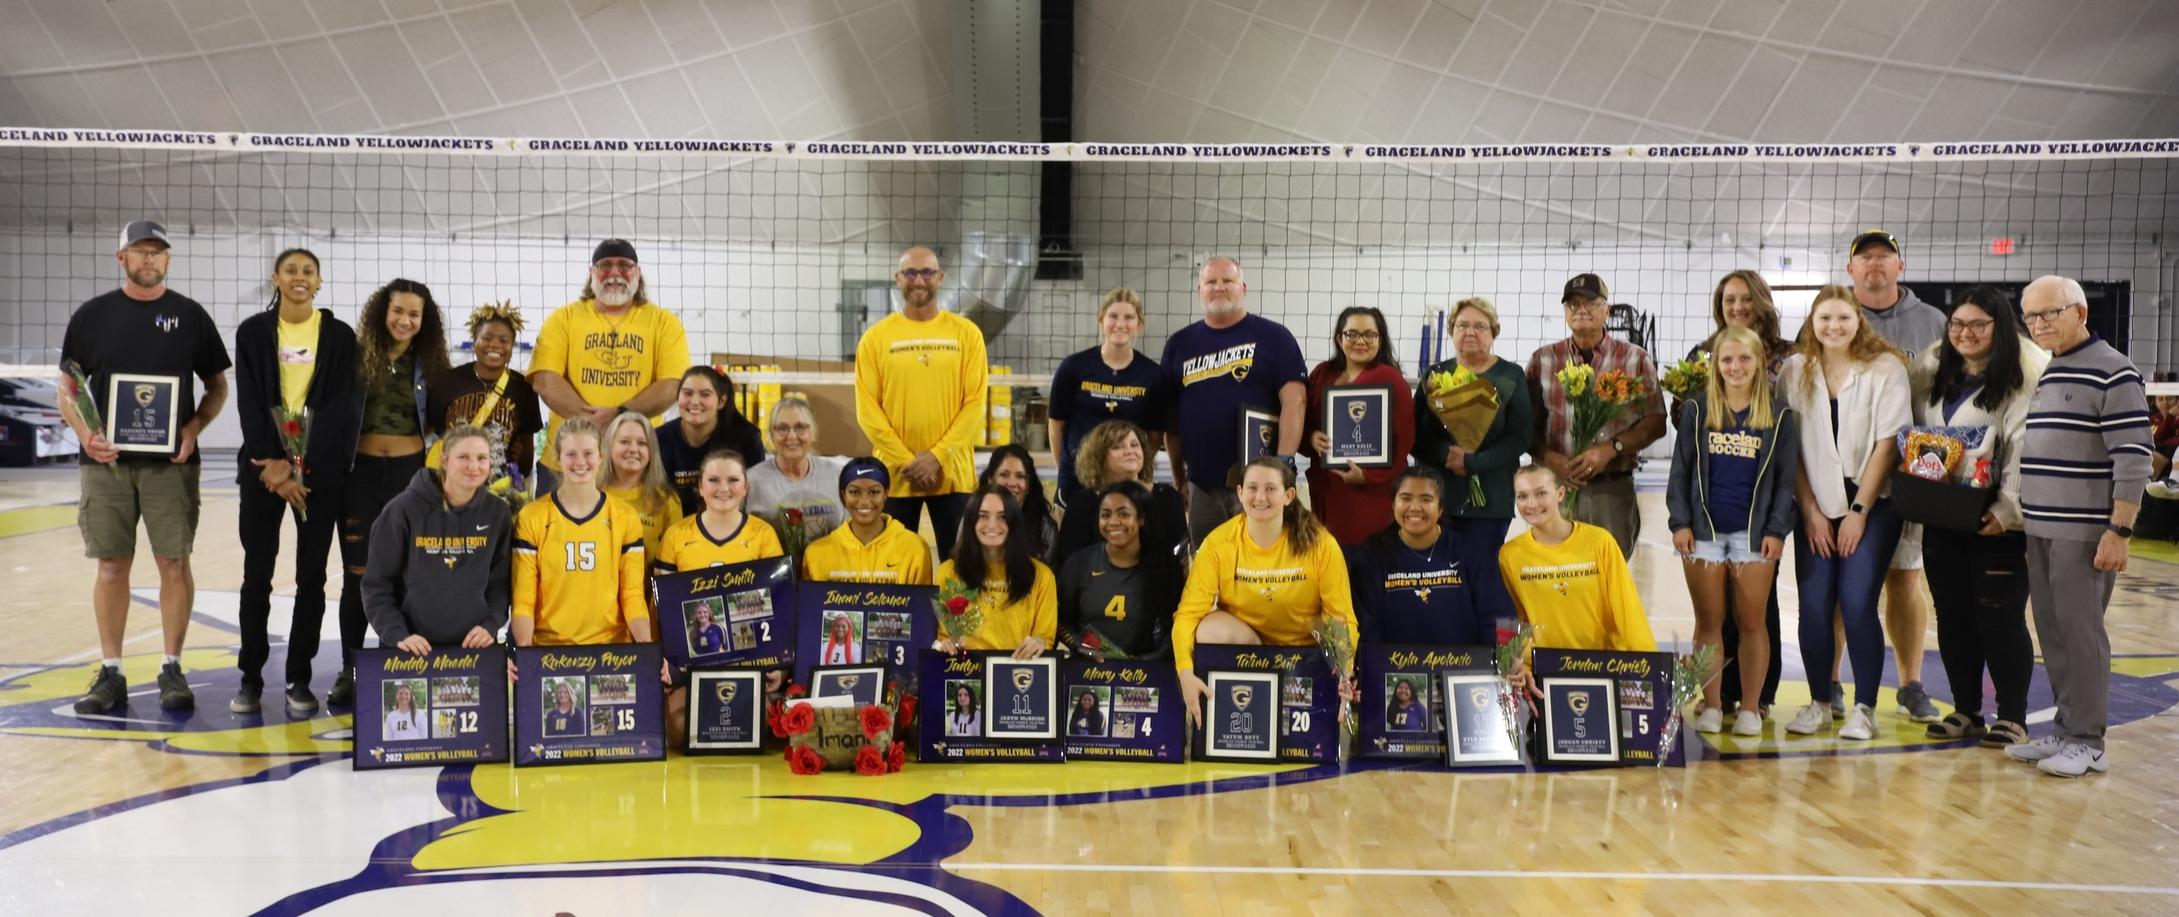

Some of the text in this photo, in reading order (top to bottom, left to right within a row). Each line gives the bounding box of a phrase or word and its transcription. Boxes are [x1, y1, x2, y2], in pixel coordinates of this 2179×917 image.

[74, 132, 216, 144] YELLOWJACKETS
[251, 136, 494, 150] GRACELAND YELLOWJACKETS
[529, 140, 773, 152] GRACELAND YELLOWJACKETS
[807, 143, 1050, 155] GRACELAND YELLOWJACKETS
[1087, 145, 1331, 157] GRACELAND YELLOWJACKETS
[1365, 146, 1611, 157] GRACELAND YELLOWJACKETS
[1648, 146, 1896, 157] GRACELAND YELLOWJACKETS
[1933, 144, 2041, 156] GRACELAND
[585, 332, 644, 354] GRACLAND
[921, 344, 960, 352] VOLLEYBALL
[1183, 343, 1256, 377] YELLOWJACKETS
[582, 367, 640, 387] UNIVERSITY
[132, 408, 156, 428] 15
[1352, 424, 1361, 443] 4
[1708, 430, 1762, 449] racelan
[416, 536, 488, 548] GRACELAD UNIERSITY
[565, 541, 596, 571] 15
[690, 568, 755, 594] Izzi Smith
[1264, 574, 1307, 584] VOLLEYBALL
[1422, 569, 1458, 578] UNIVERSITY
[1520, 567, 1600, 581] WOMEN'S VOLLEYBALL
[1385, 579, 1418, 588] WOMEN'S
[824, 590, 911, 607] Imani Solomon
[1104, 594, 1127, 621] 4
[760, 621, 772, 642] 2
[384, 654, 479, 674] Maddy Maedel
[601, 652, 637, 671] Pryor
[895, 645, 905, 665] 3
[1236, 652, 1302, 671] Tatum Butt
[1389, 651, 1472, 670] Kyla Apolonio
[1083, 667, 1147, 685] Mary Kelly
[1560, 656, 1651, 678] Jordan Christy
[1012, 694, 1031, 715] 11
[460, 711, 478, 733] 12
[617, 709, 635, 731] 15
[720, 706, 731, 725] 2
[1230, 712, 1253, 733] 20
[1292, 711, 1311, 732] 20
[1639, 714, 1649, 735] 5
[1141, 717, 1152, 736] 4
[1574, 717, 1586, 738] 5
[817, 726, 871, 748] Iman
[385, 749, 478, 763] 2022 WOMEN'S VOLLEYBALL
[545, 747, 635, 759] 2022 WOMEN'S VOLLEYBALL
[947, 748, 1035, 757] 2022 WOMEN'S VOLLEYBALL
[1066, 747, 1154, 757] 2022 WOMEN'S VOLLEYBALL
[1282, 748, 1309, 757] LEYBALL
[1388, 743, 1404, 752] 2022
[1405, 743, 1437, 752] WOMEN'S
